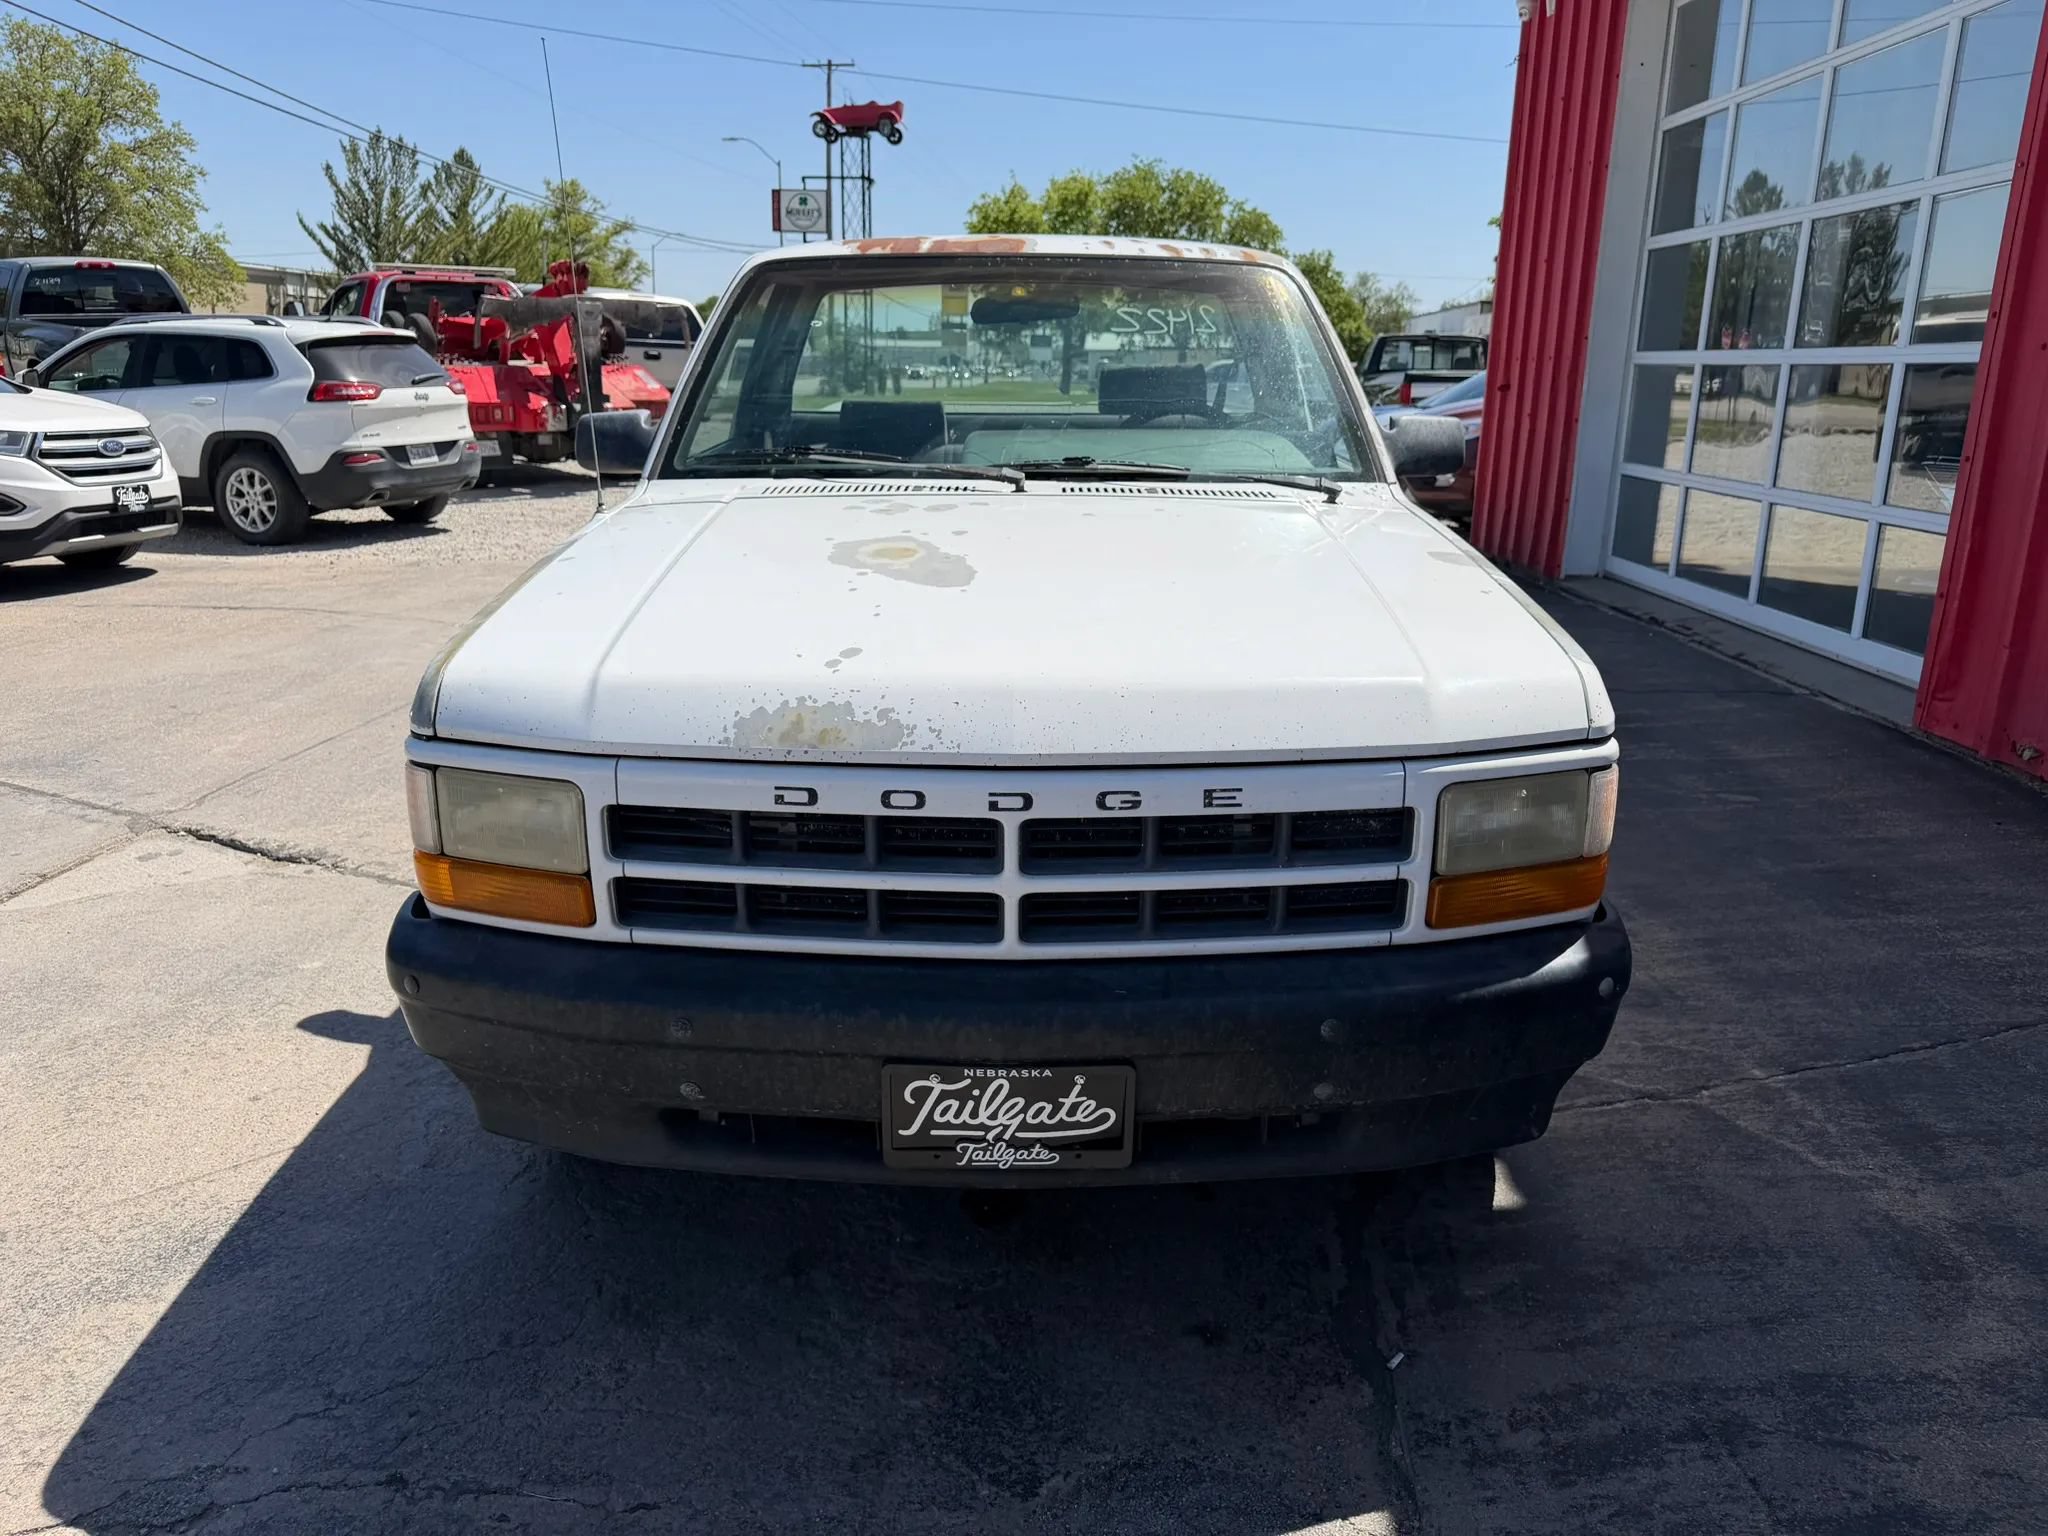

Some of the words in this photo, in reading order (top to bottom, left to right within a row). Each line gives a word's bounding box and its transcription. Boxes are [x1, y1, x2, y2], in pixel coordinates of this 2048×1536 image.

[774, 786, 1243, 812] DODGE
[964, 1068, 1053, 1078] NEBRASKA
[898, 1078, 1116, 1144] Tailgate
[956, 1140, 1060, 1170] Tailgate
